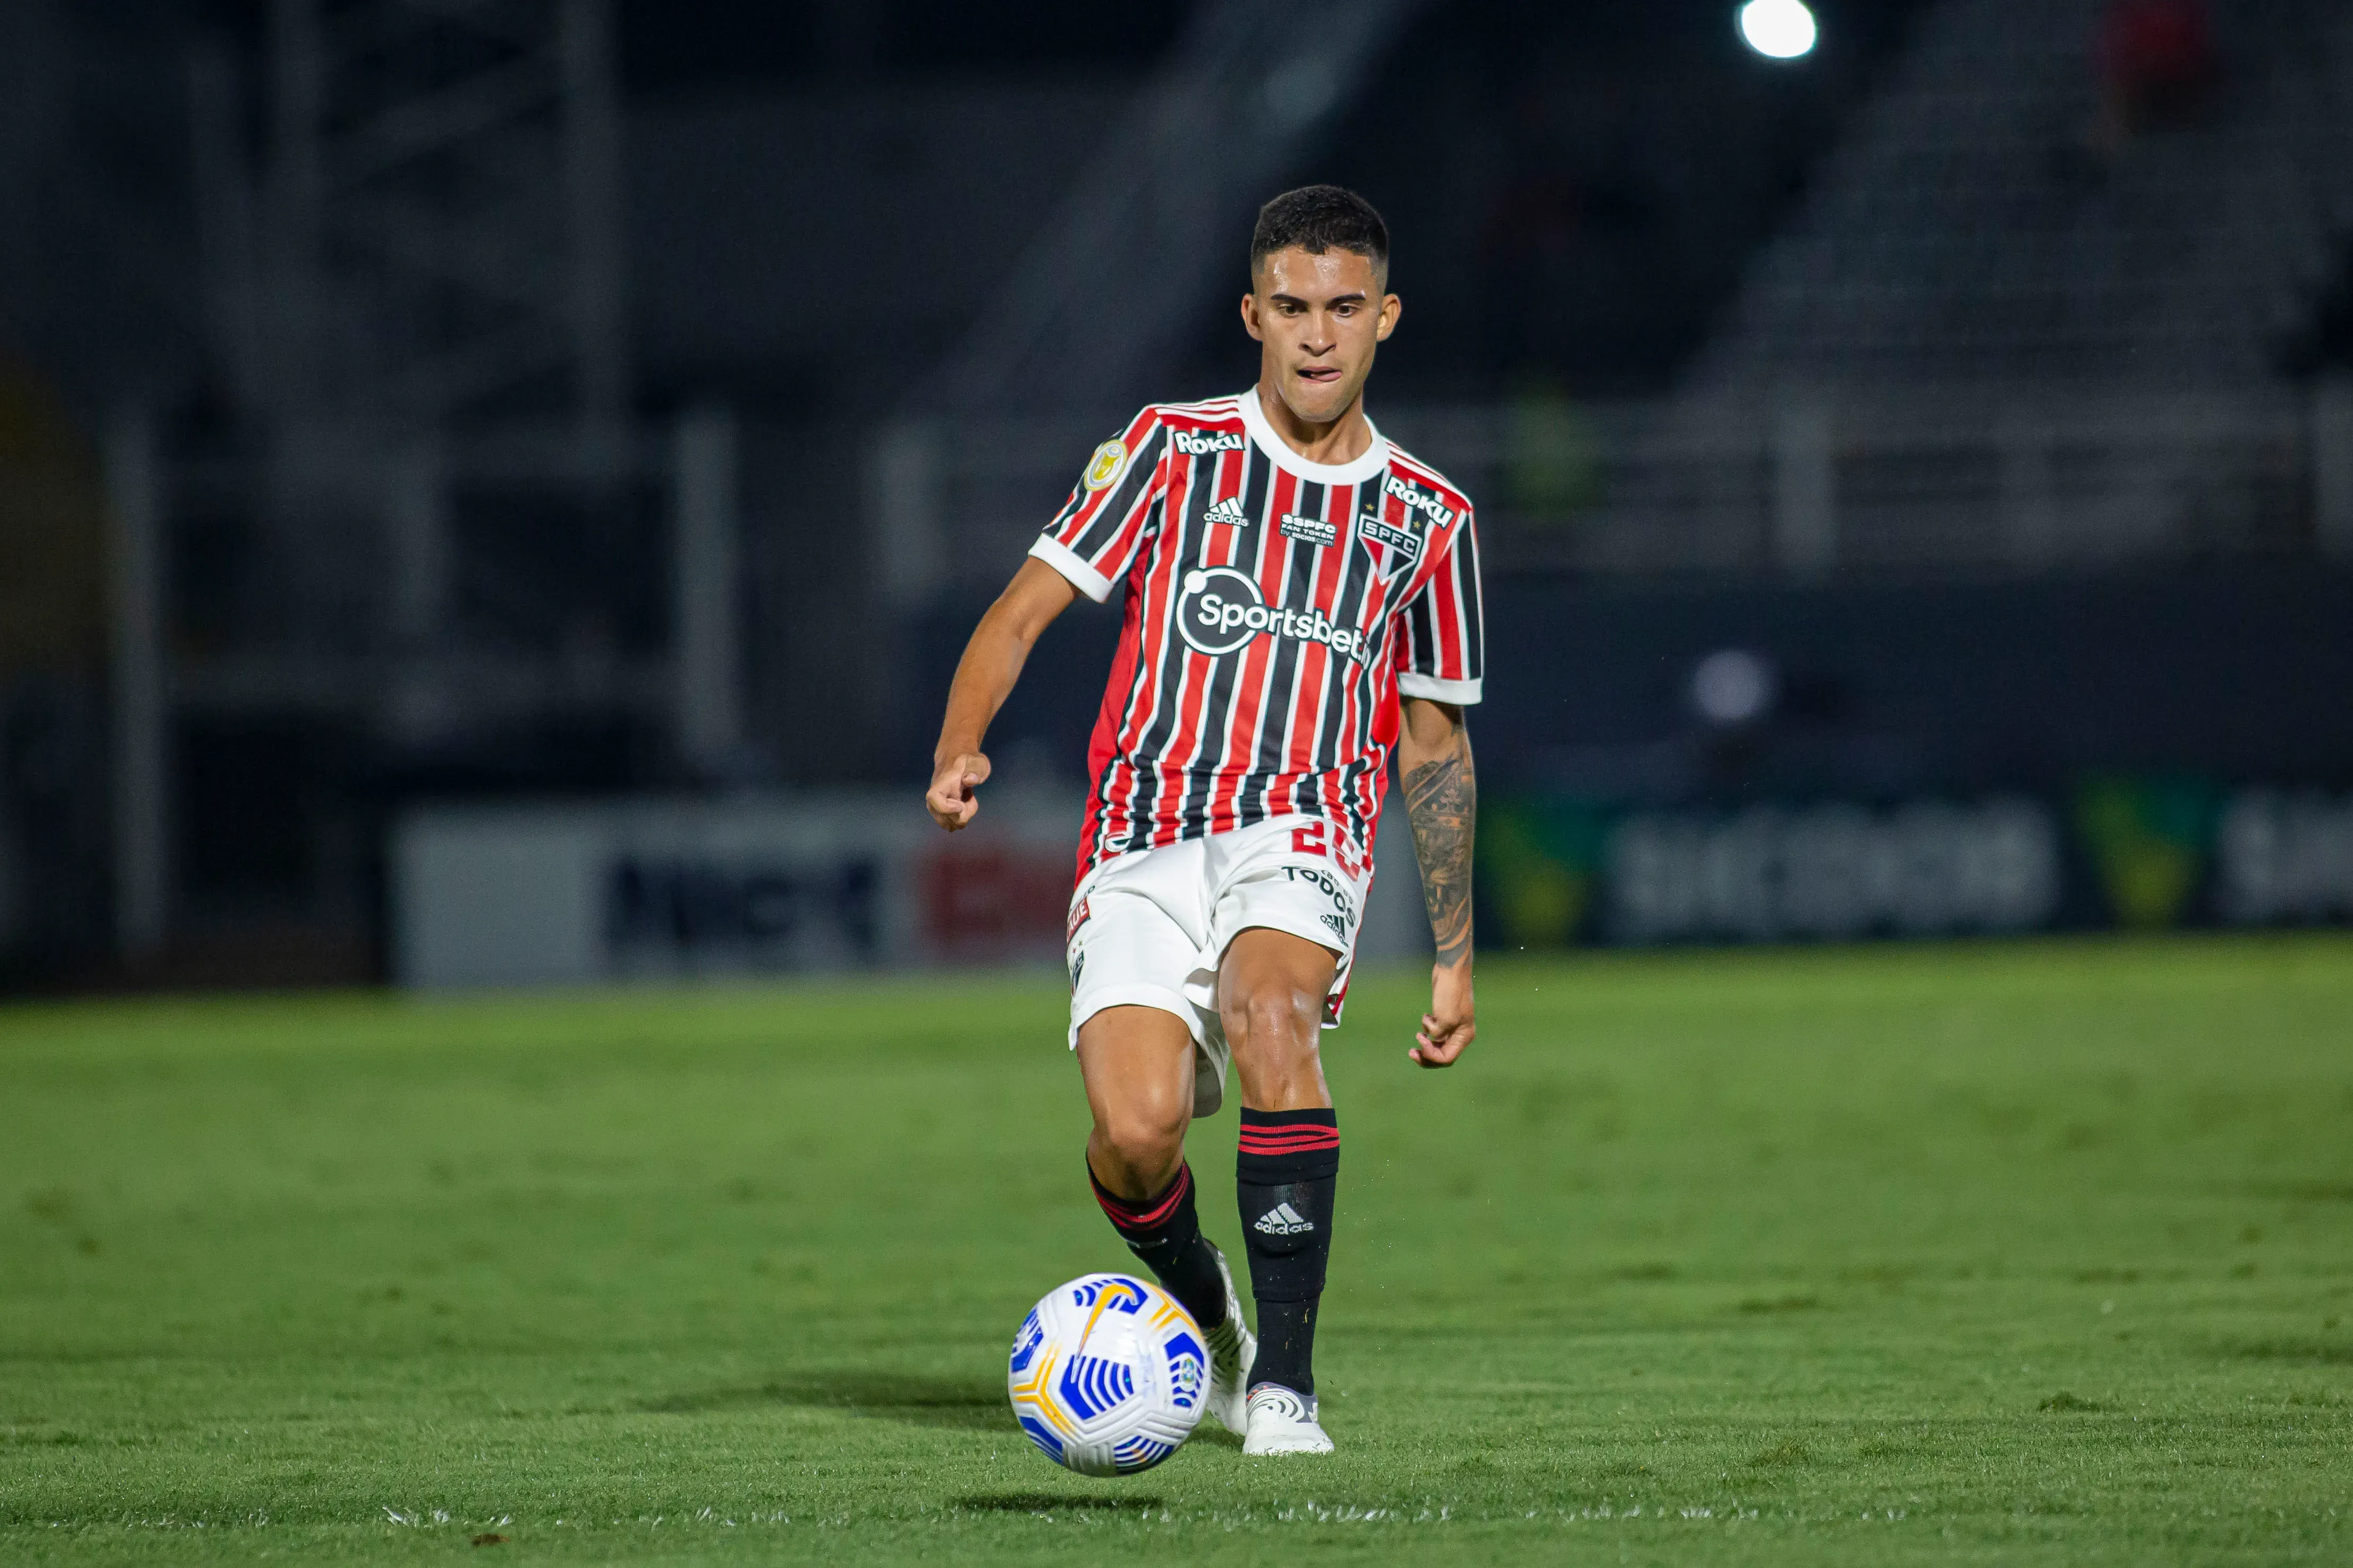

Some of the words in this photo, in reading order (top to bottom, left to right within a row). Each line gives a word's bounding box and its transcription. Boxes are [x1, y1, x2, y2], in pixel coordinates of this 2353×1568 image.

[1204, 511, 1249, 527] adidas
[1282, 513, 1336, 534] SSPFC
[1281, 523, 1300, 532] FAN
[1303, 528, 1334, 540] TOKEN
[1364, 521, 1416, 553] SPFC
[1281, 866, 1356, 928] TODOS
[1254, 1220, 1315, 1235] adidas
